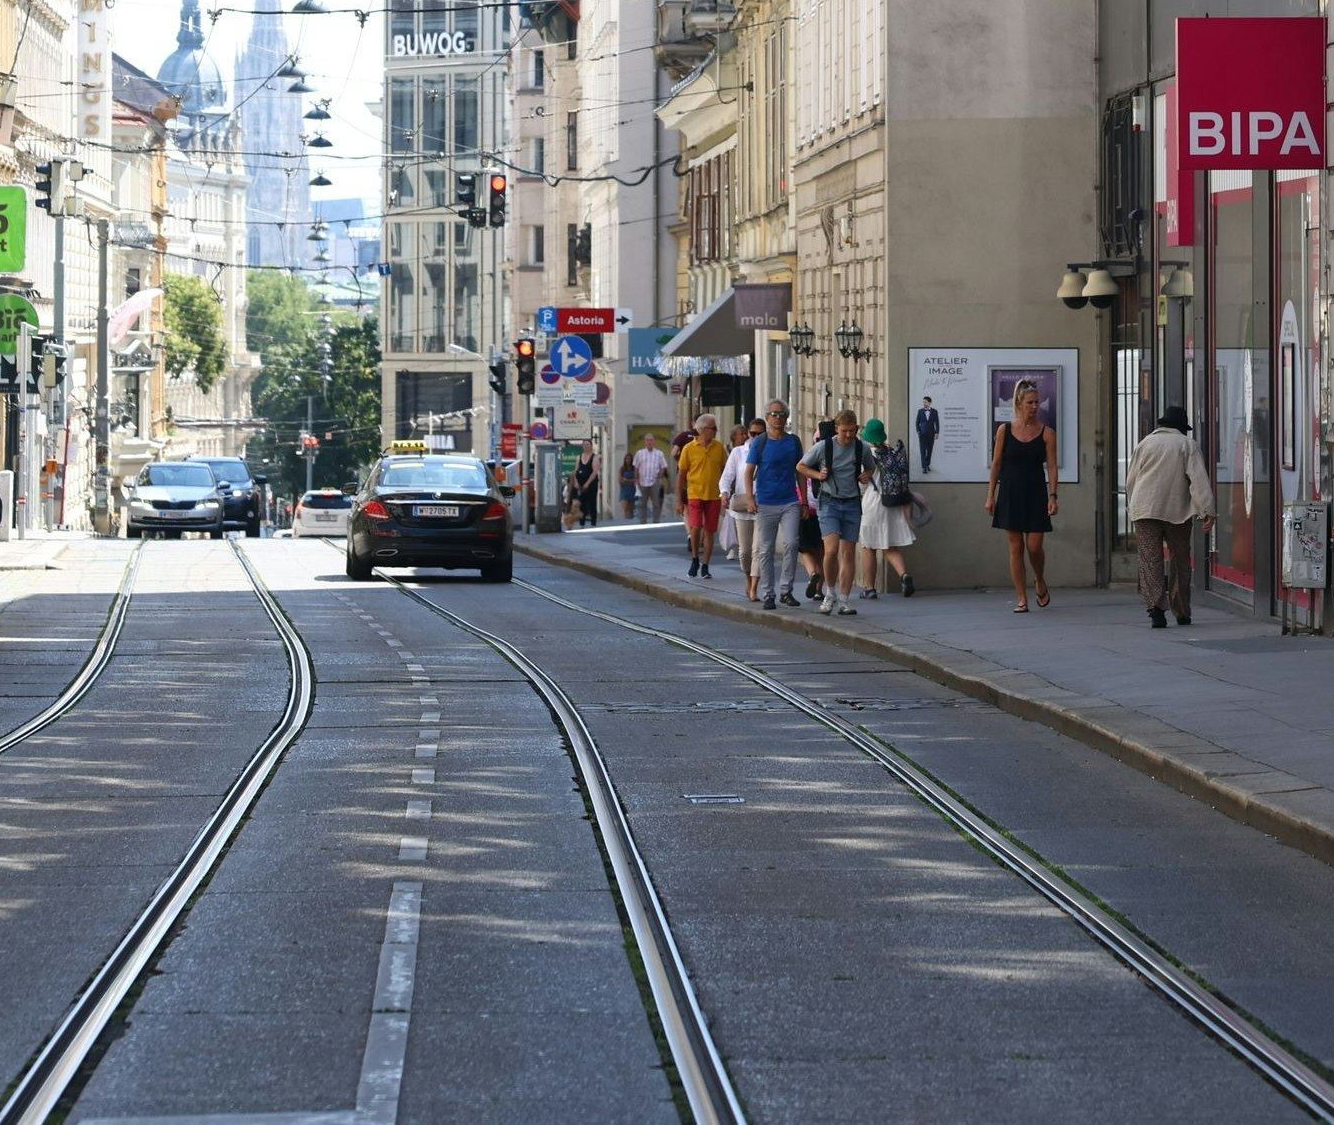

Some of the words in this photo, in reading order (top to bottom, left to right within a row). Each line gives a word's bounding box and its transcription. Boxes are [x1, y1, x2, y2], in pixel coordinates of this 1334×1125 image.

[394, 31, 466, 56] BUWOG
[1189, 111, 1321, 156] BIPA
[567, 315, 605, 325] Astoria
[740, 312, 778, 325] mala
[923, 357, 968, 365] ATELIER
[929, 367, 963, 375] IMAGE
